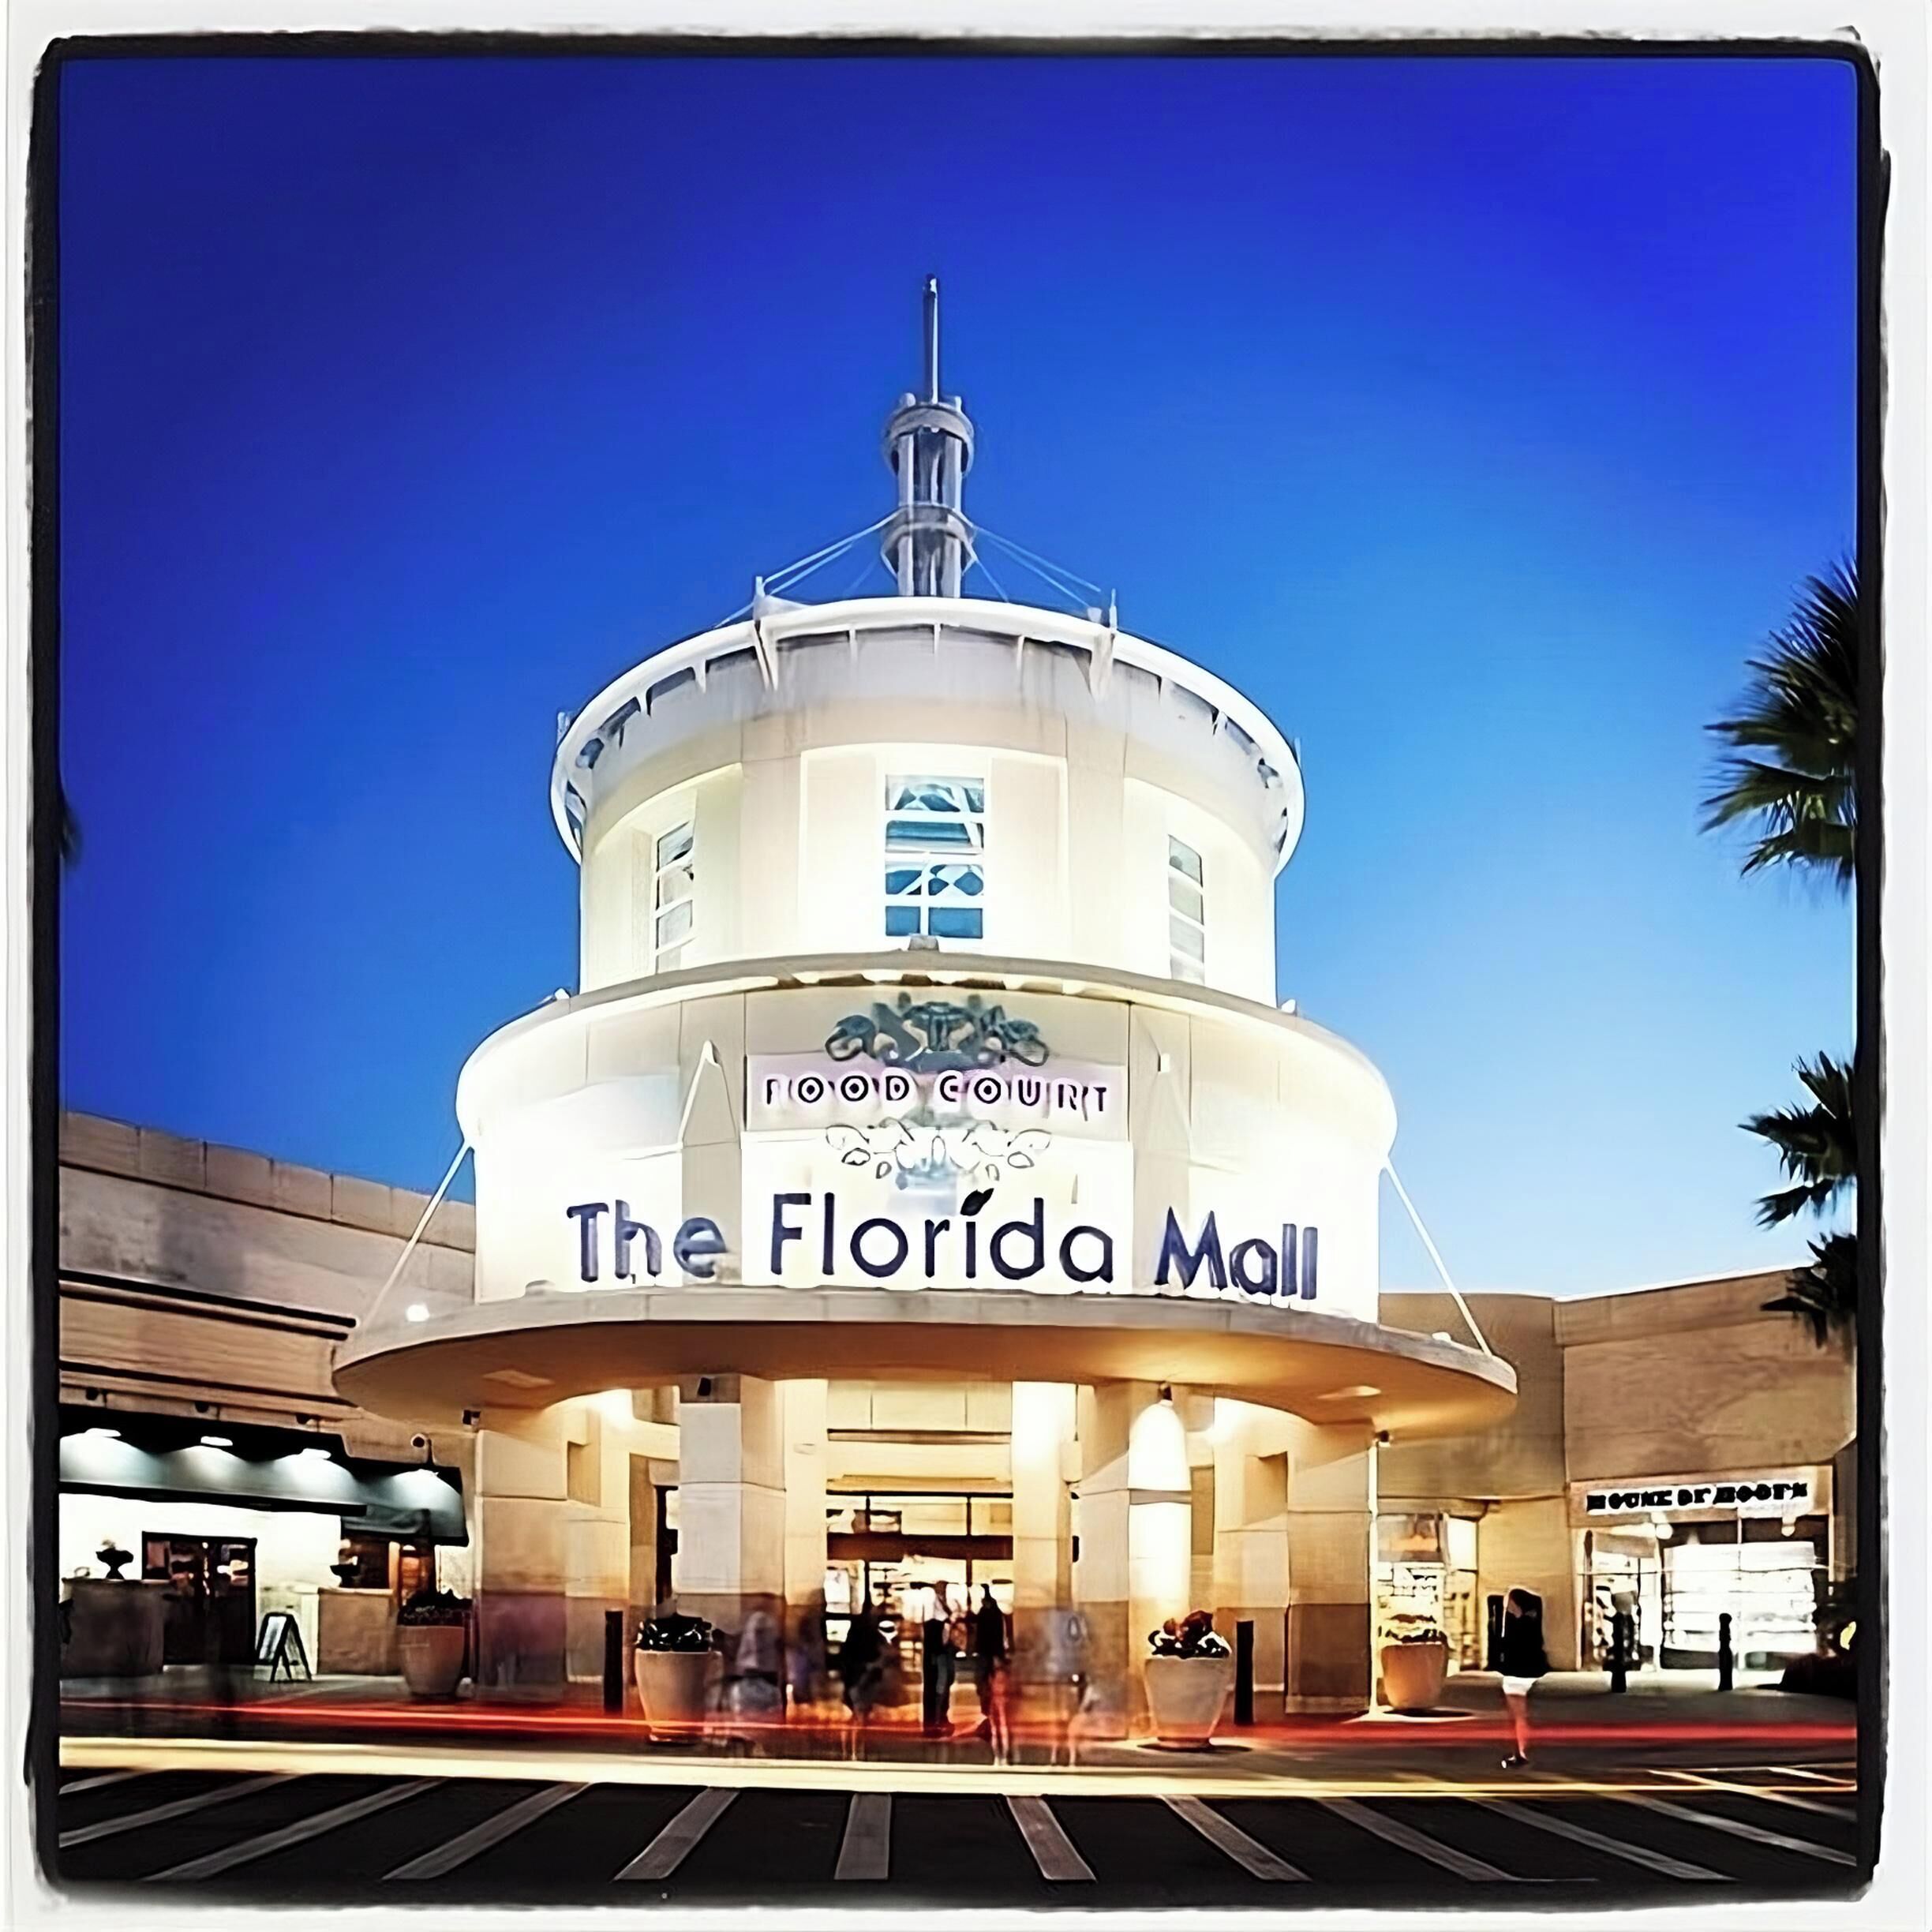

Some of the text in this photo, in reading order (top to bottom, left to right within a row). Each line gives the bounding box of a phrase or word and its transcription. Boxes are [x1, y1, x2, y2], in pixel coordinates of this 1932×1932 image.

[766, 1075, 1107, 1111] FOOD COURT
[566, 1188, 1319, 1300] The Florida Mall
